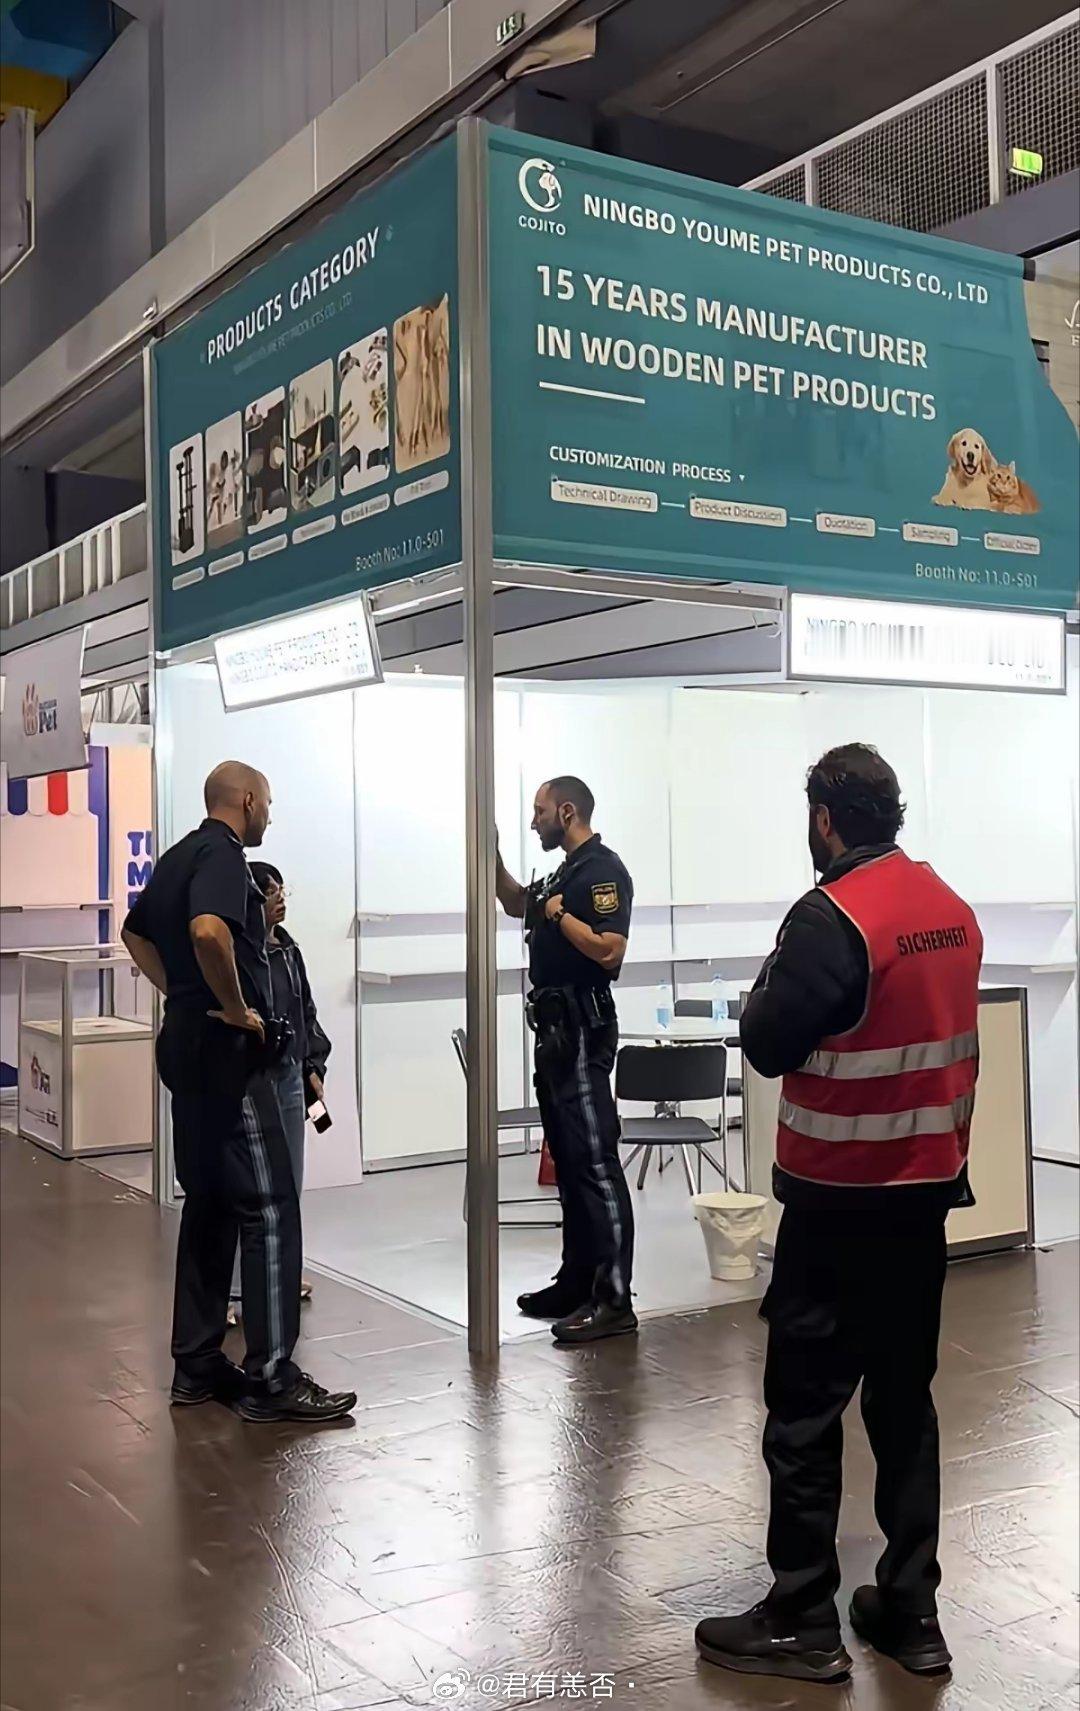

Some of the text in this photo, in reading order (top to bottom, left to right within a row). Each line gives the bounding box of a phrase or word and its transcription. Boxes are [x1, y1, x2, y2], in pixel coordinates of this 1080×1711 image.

[518, 215, 566, 236] COJITO
[583, 193, 676, 235] NINGBO
[682, 216, 761, 255] YOUME
[766, 237, 803, 264] PET
[808, 246, 912, 289] PRODUCTS
[957, 281, 988, 304] LTD
[207, 293, 283, 365] PRODUCTS
[289, 226, 379, 311] CATEGORY
[537, 265, 928, 369] 15 YEARS MANUFACTURER
[537, 324, 936, 421] IN WOODEN PET PRODUCTS
[549, 445, 732, 483] CUSTOMIZATION PROCESS
[558, 484, 652, 509] Technical Drawing
[694, 501, 783, 522] Product Discussion
[915, 563, 955, 580] Booth
[959, 567, 981, 583] No:
[896, 925, 968, 956] SICHERHEIT
